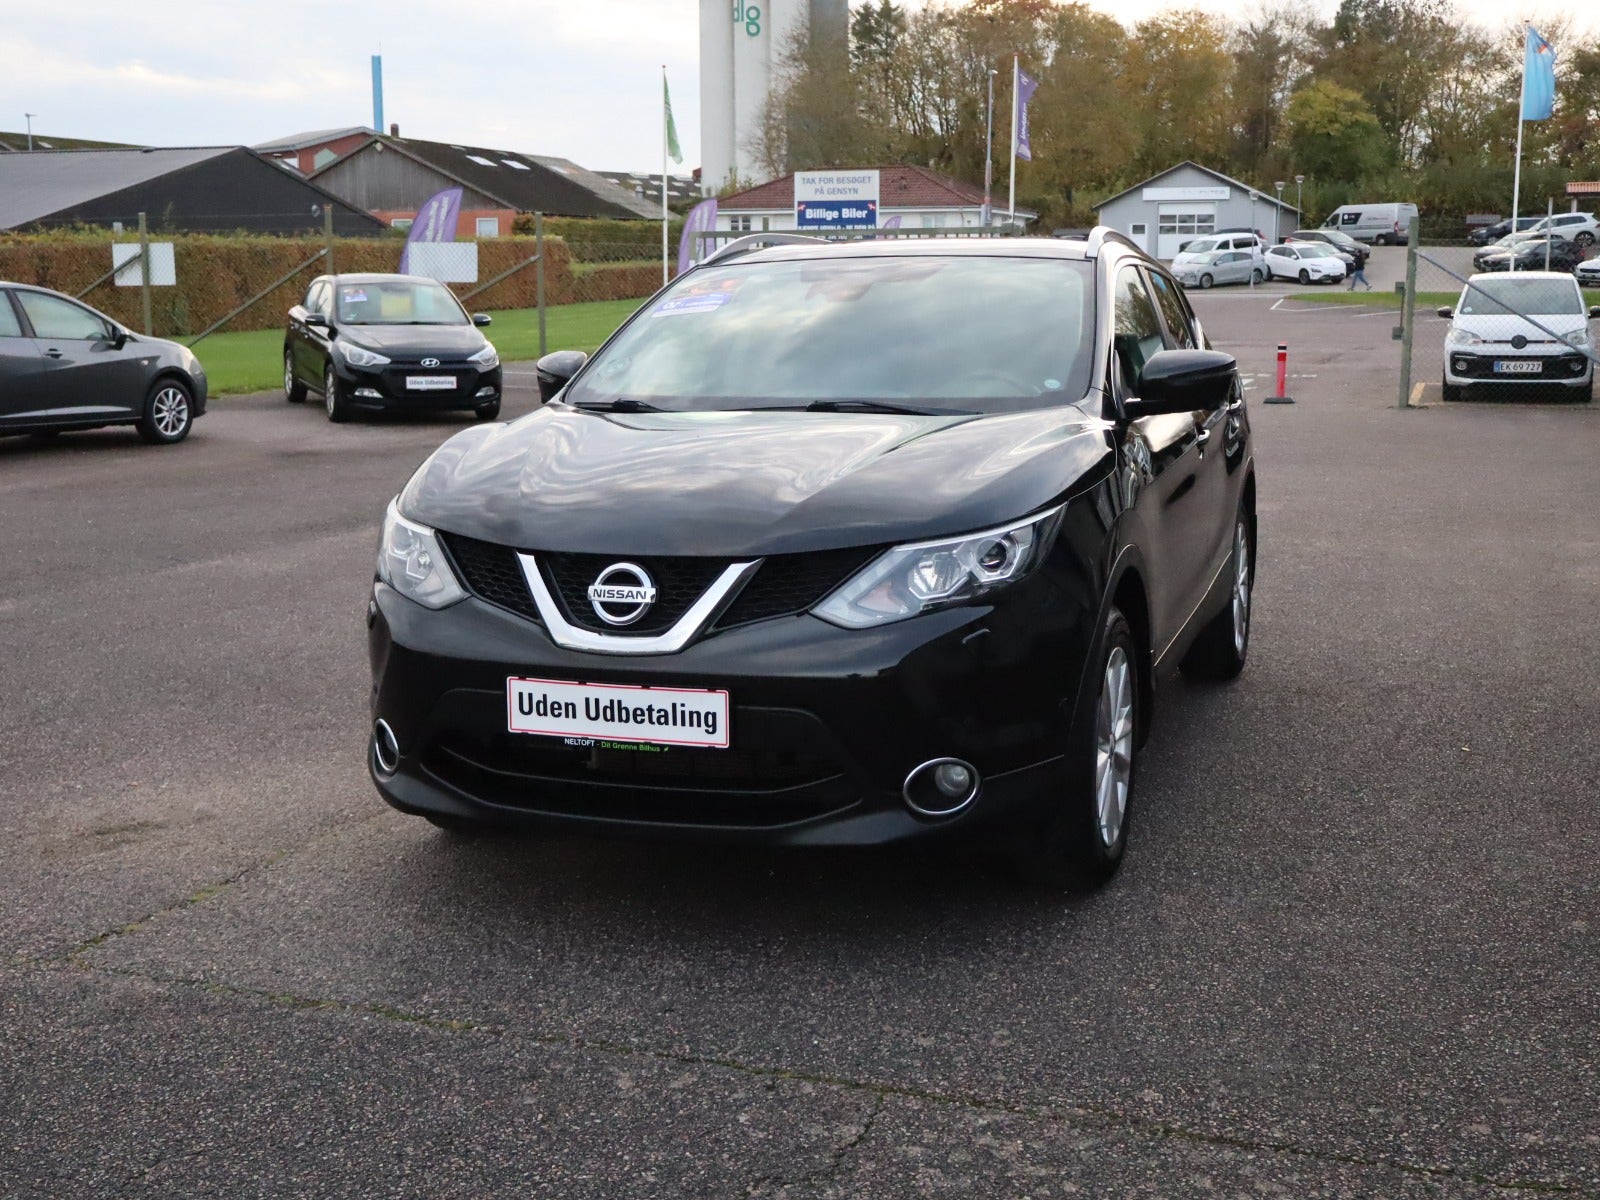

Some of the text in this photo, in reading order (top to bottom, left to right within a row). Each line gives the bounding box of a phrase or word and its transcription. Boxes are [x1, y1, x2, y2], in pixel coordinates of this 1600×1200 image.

[805, 208, 868, 220] Billige Biler
[1500, 363, 1540, 371] EK 69 727
[593, 588, 647, 600] NISSAN
[518, 691, 717, 734] Uden Udbetaling
[564, 738, 595, 747] NELTOFT
[639, 744, 660, 752] Bilhus
